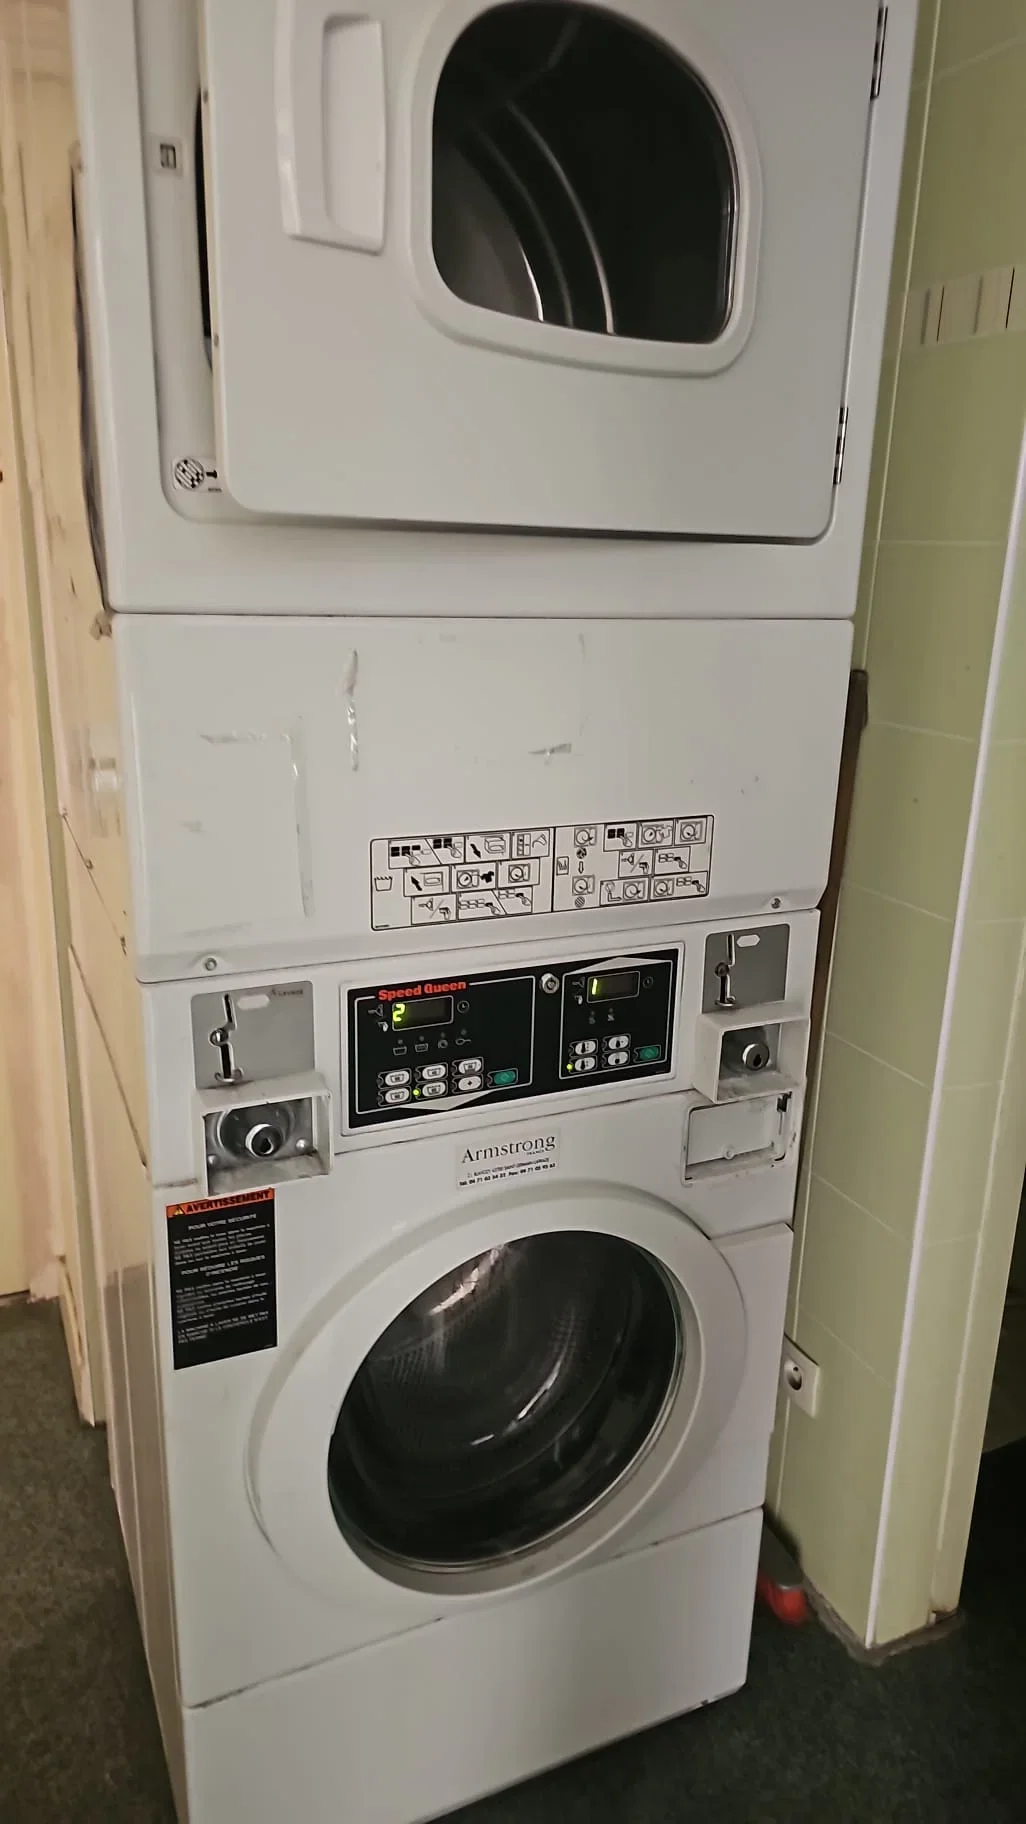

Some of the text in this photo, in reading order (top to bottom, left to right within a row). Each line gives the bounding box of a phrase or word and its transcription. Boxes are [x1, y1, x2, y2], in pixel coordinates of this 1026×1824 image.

[378, 981, 467, 1001] Speed Queen
[392, 1003, 406, 1022] 2
[461, 1135, 556, 1163] Armstrong
[186, 1190, 270, 1213] AVERTISSEMENT
